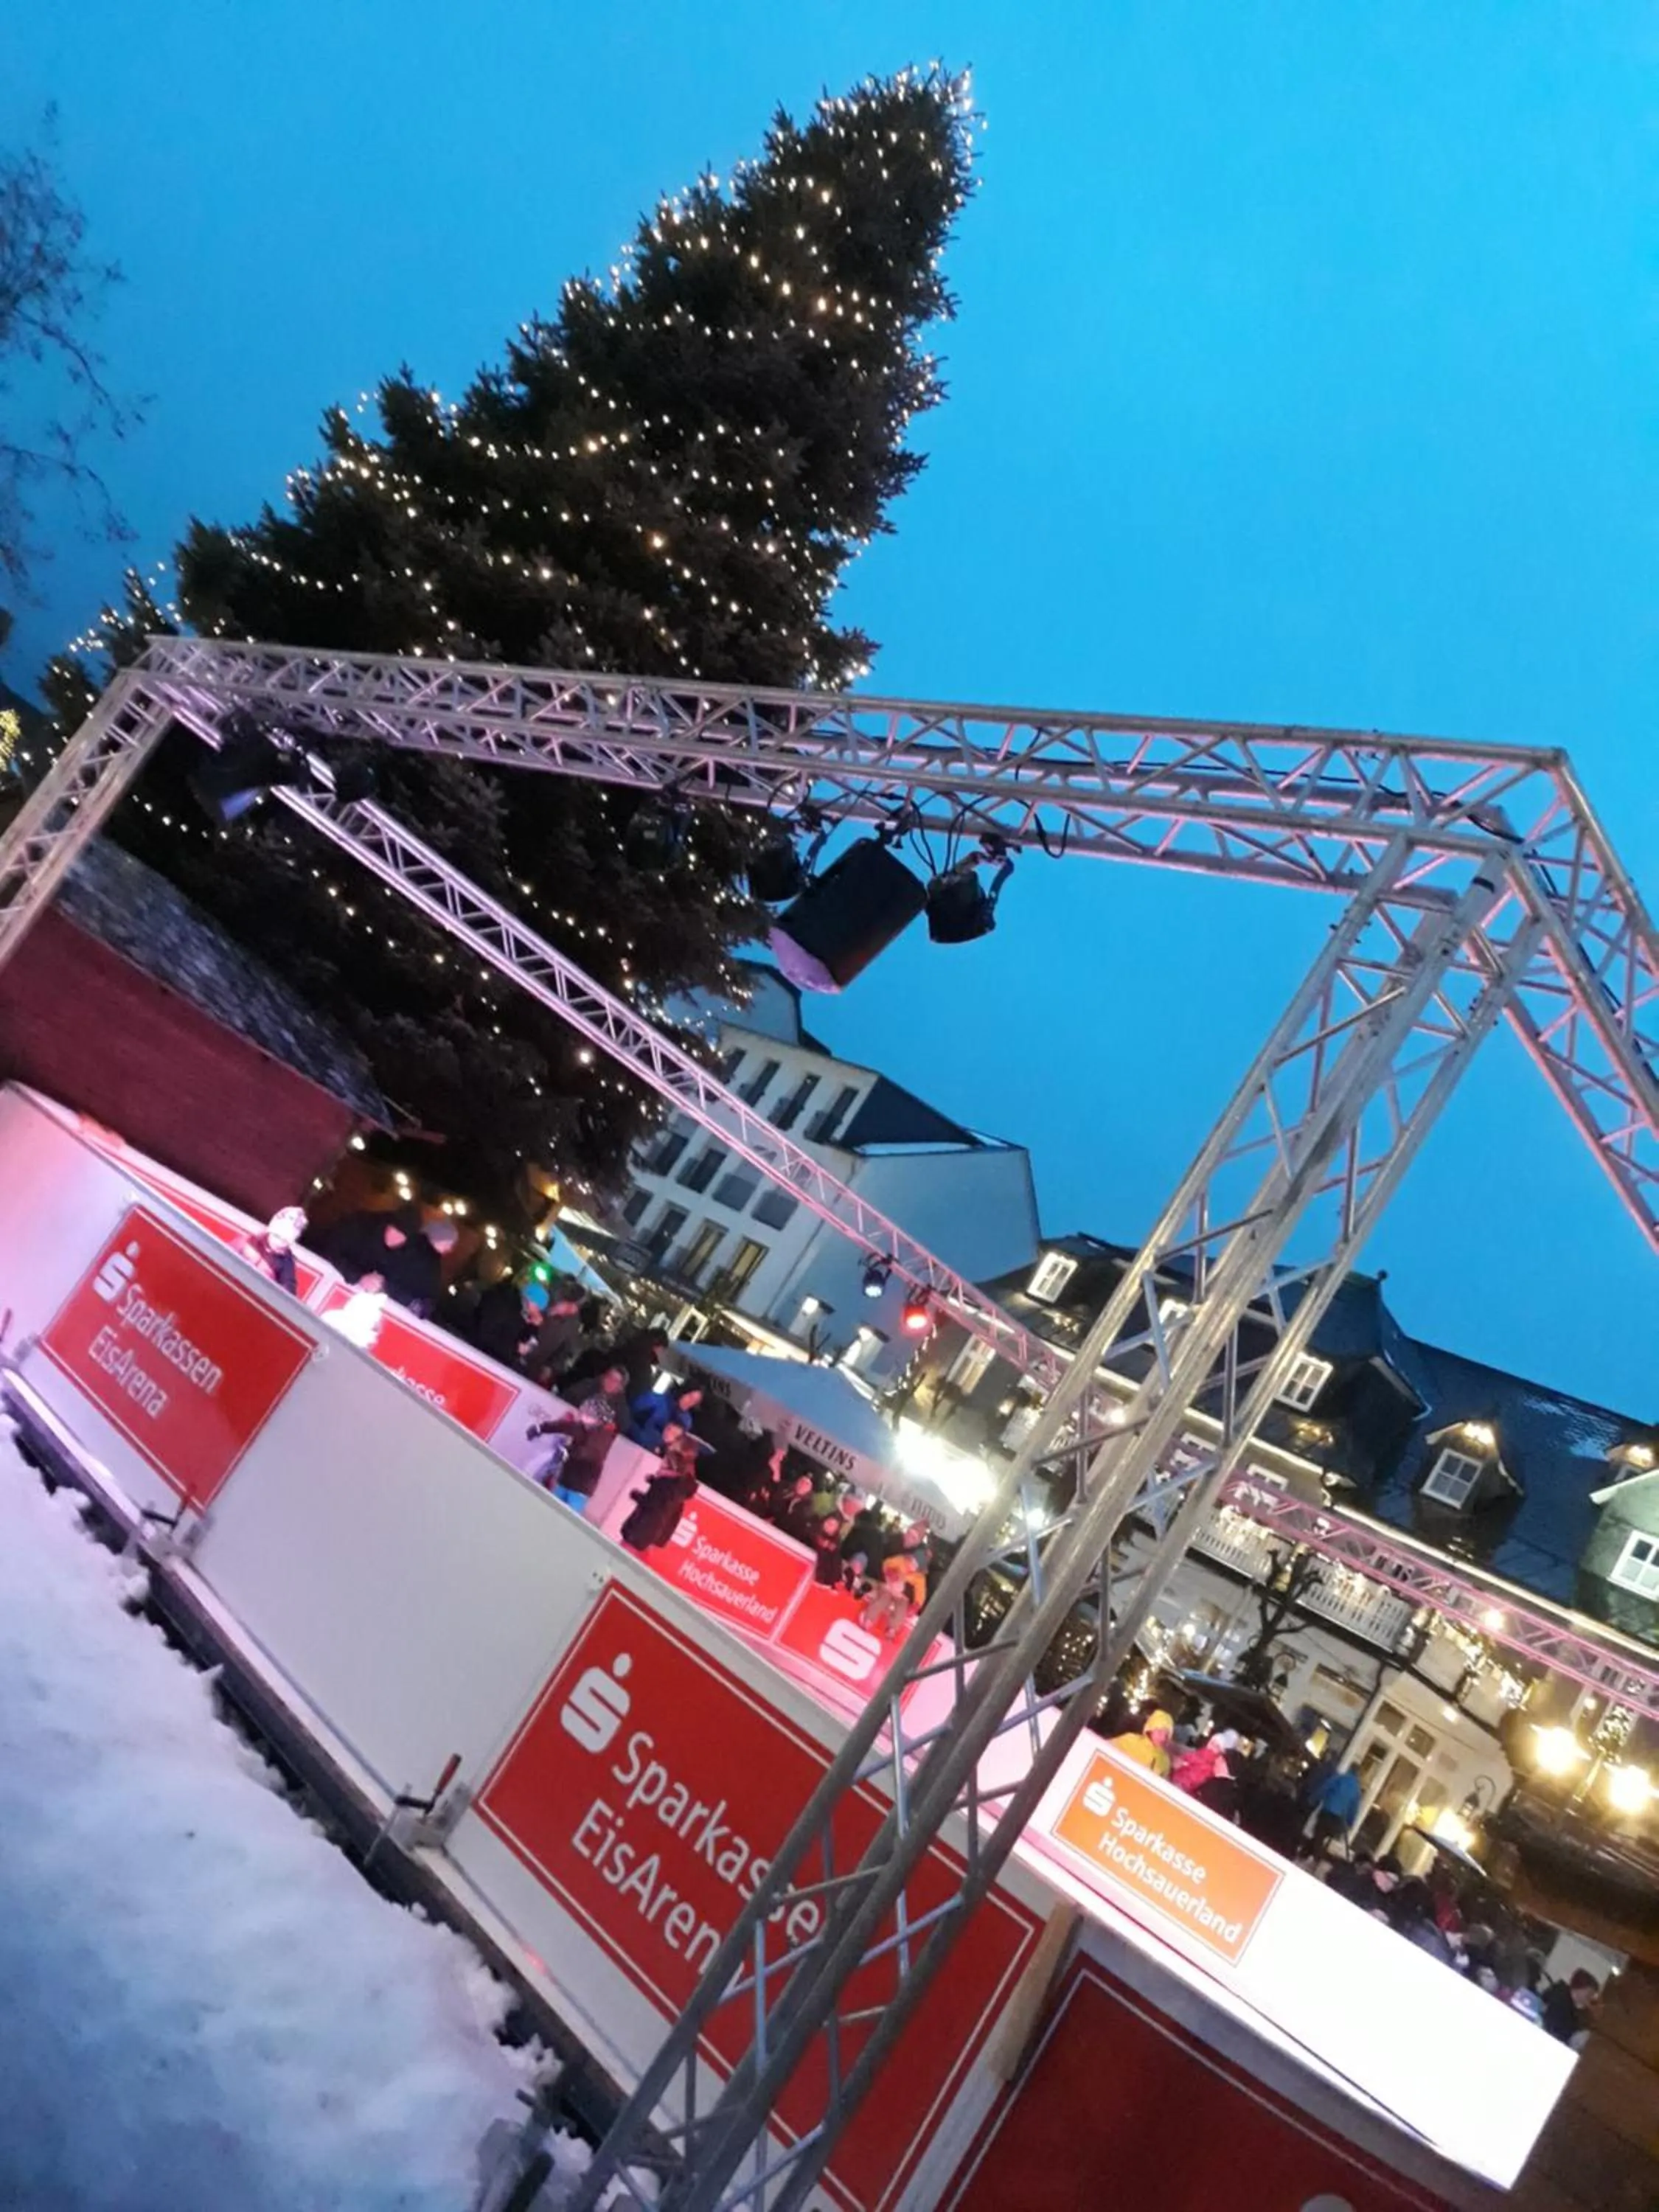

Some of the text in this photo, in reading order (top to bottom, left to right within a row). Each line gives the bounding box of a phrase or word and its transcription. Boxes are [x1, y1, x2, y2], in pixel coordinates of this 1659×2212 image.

[88, 1325, 168, 1419] EisArena
[116, 1282, 223, 1394] Sparkassen
[792, 1423, 859, 1473] VELTINS
[678, 1559, 779, 1623] Hochsauerland
[692, 1534, 760, 1586] Sparkasse
[1098, 1831, 1243, 1943] Hochsauerland
[1110, 1806, 1207, 1884] Sparkasse
[571, 1798, 744, 1992] EisAren
